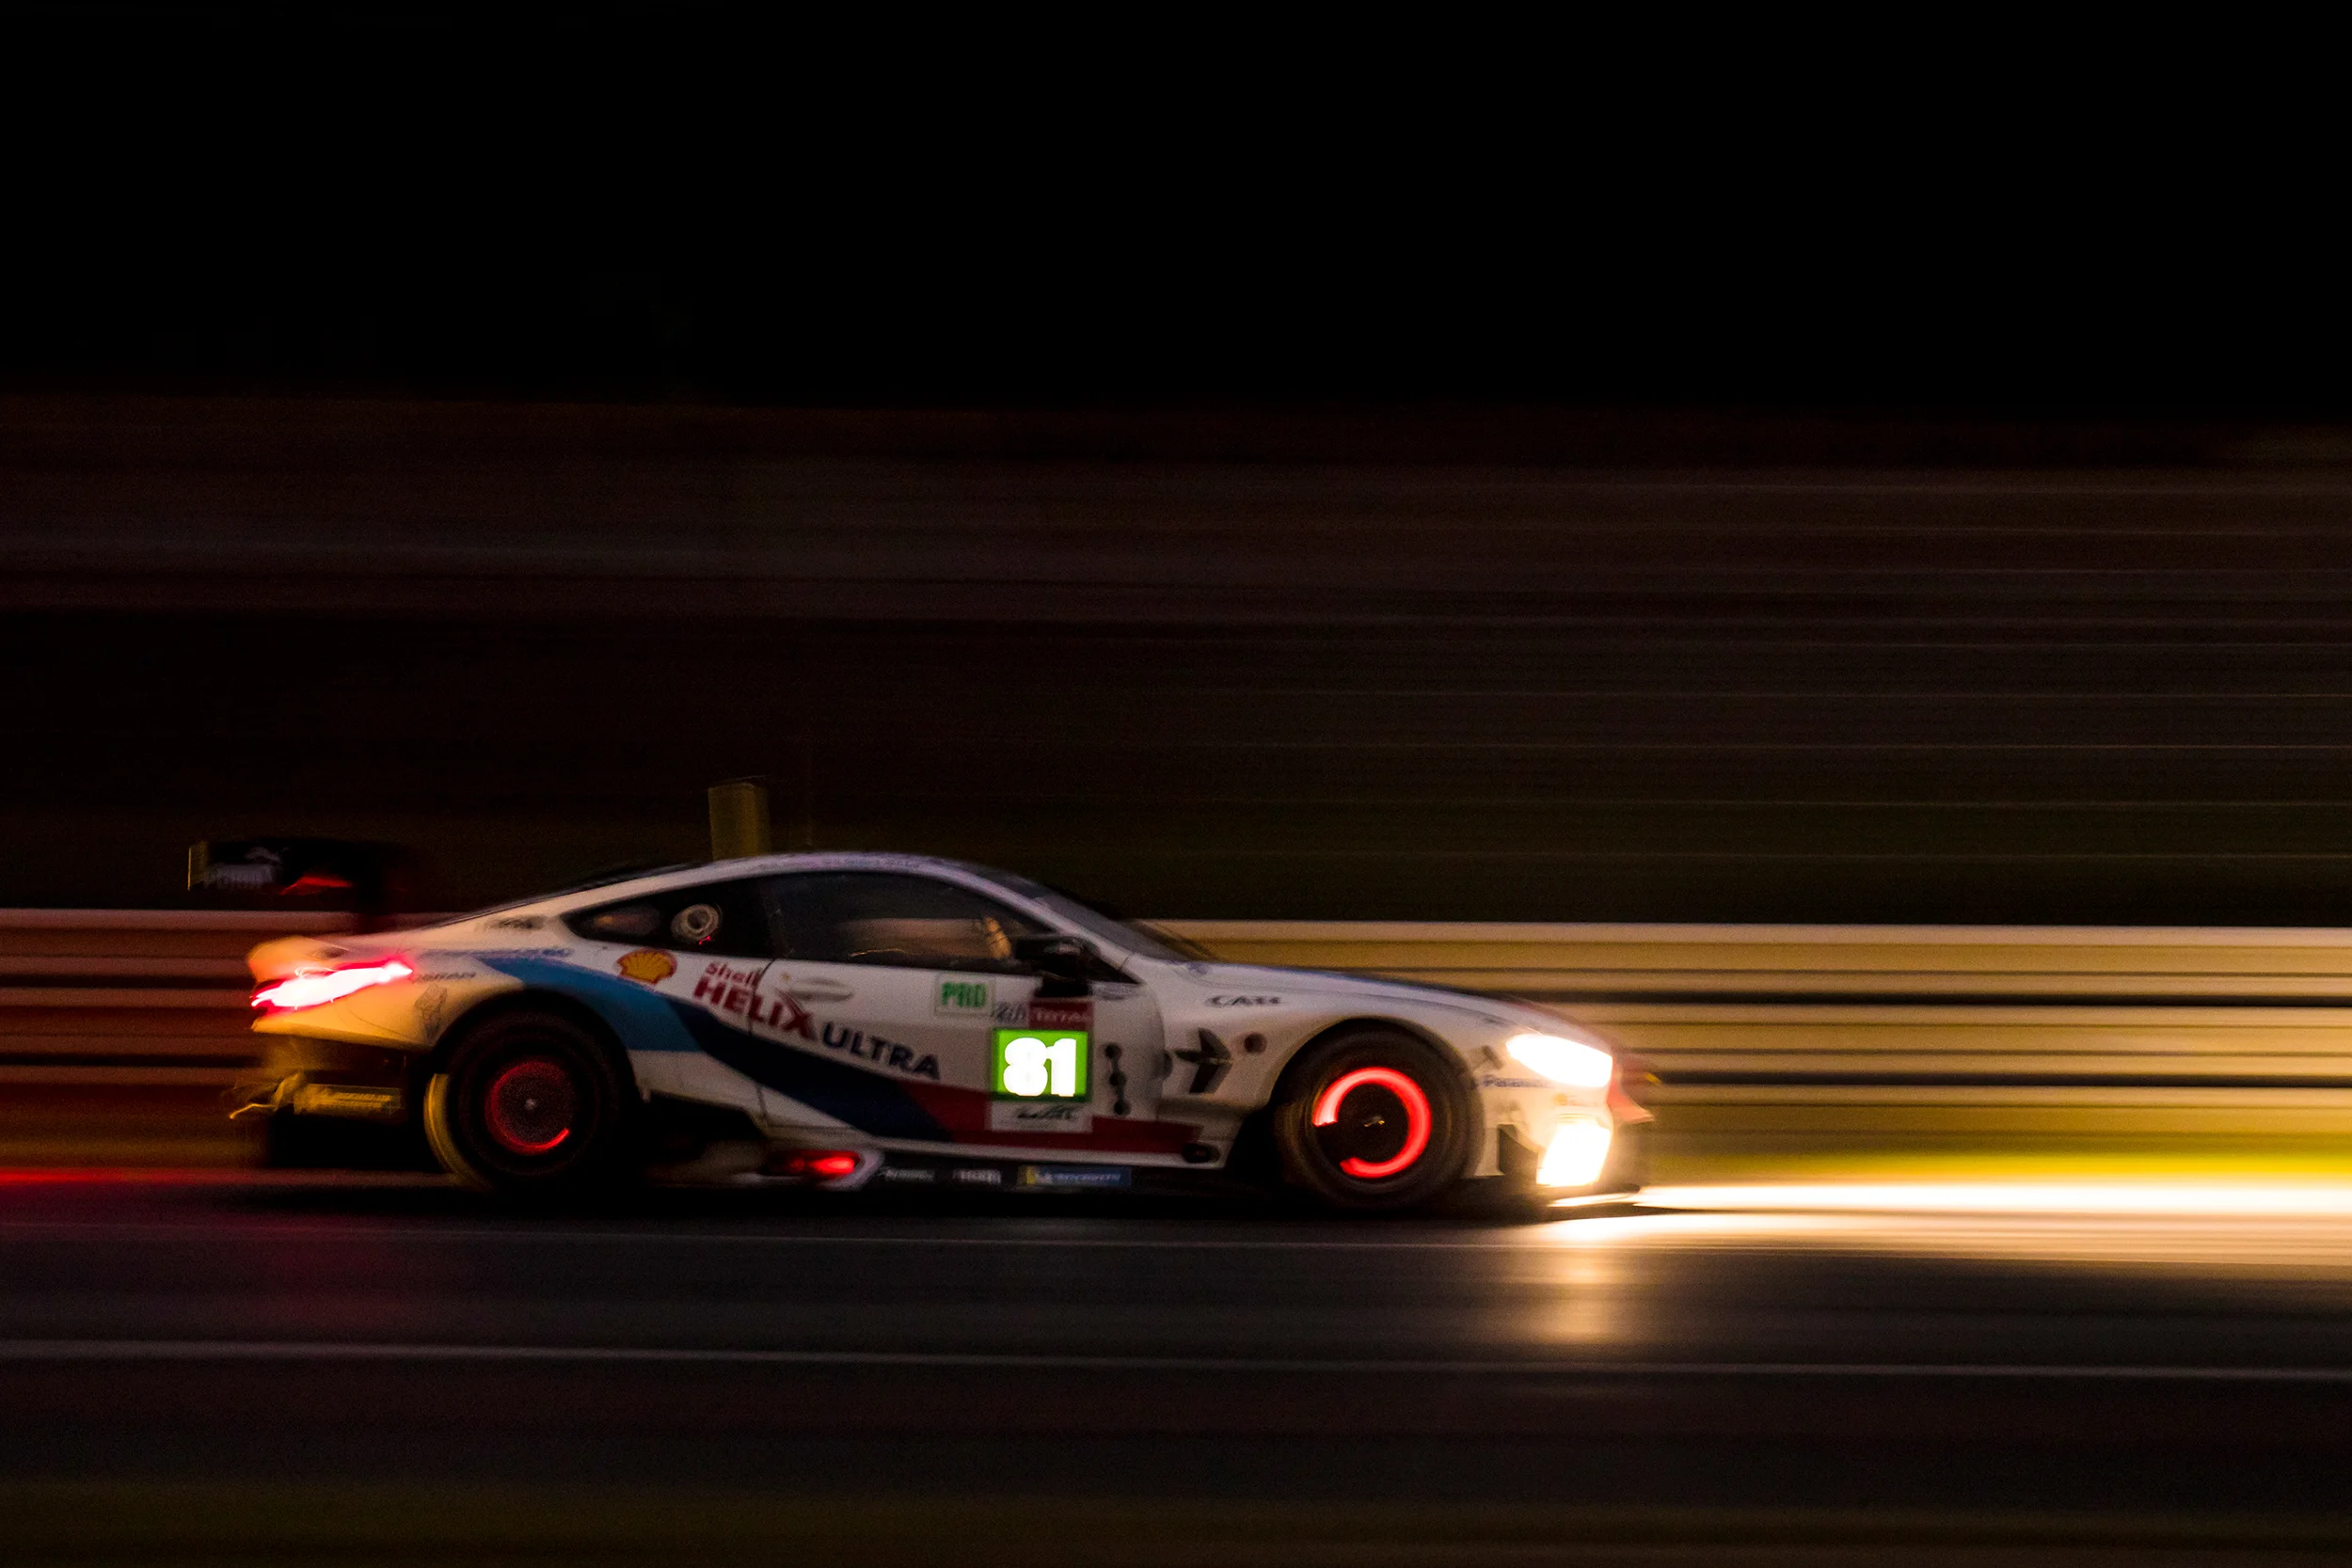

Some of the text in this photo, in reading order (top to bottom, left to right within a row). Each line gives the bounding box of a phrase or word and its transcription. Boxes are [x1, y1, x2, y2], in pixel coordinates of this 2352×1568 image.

[705, 961, 761, 988] Shell
[692, 975, 940, 1081] HELIX ULTRA
[1003, 1037, 1077, 1098] 81
